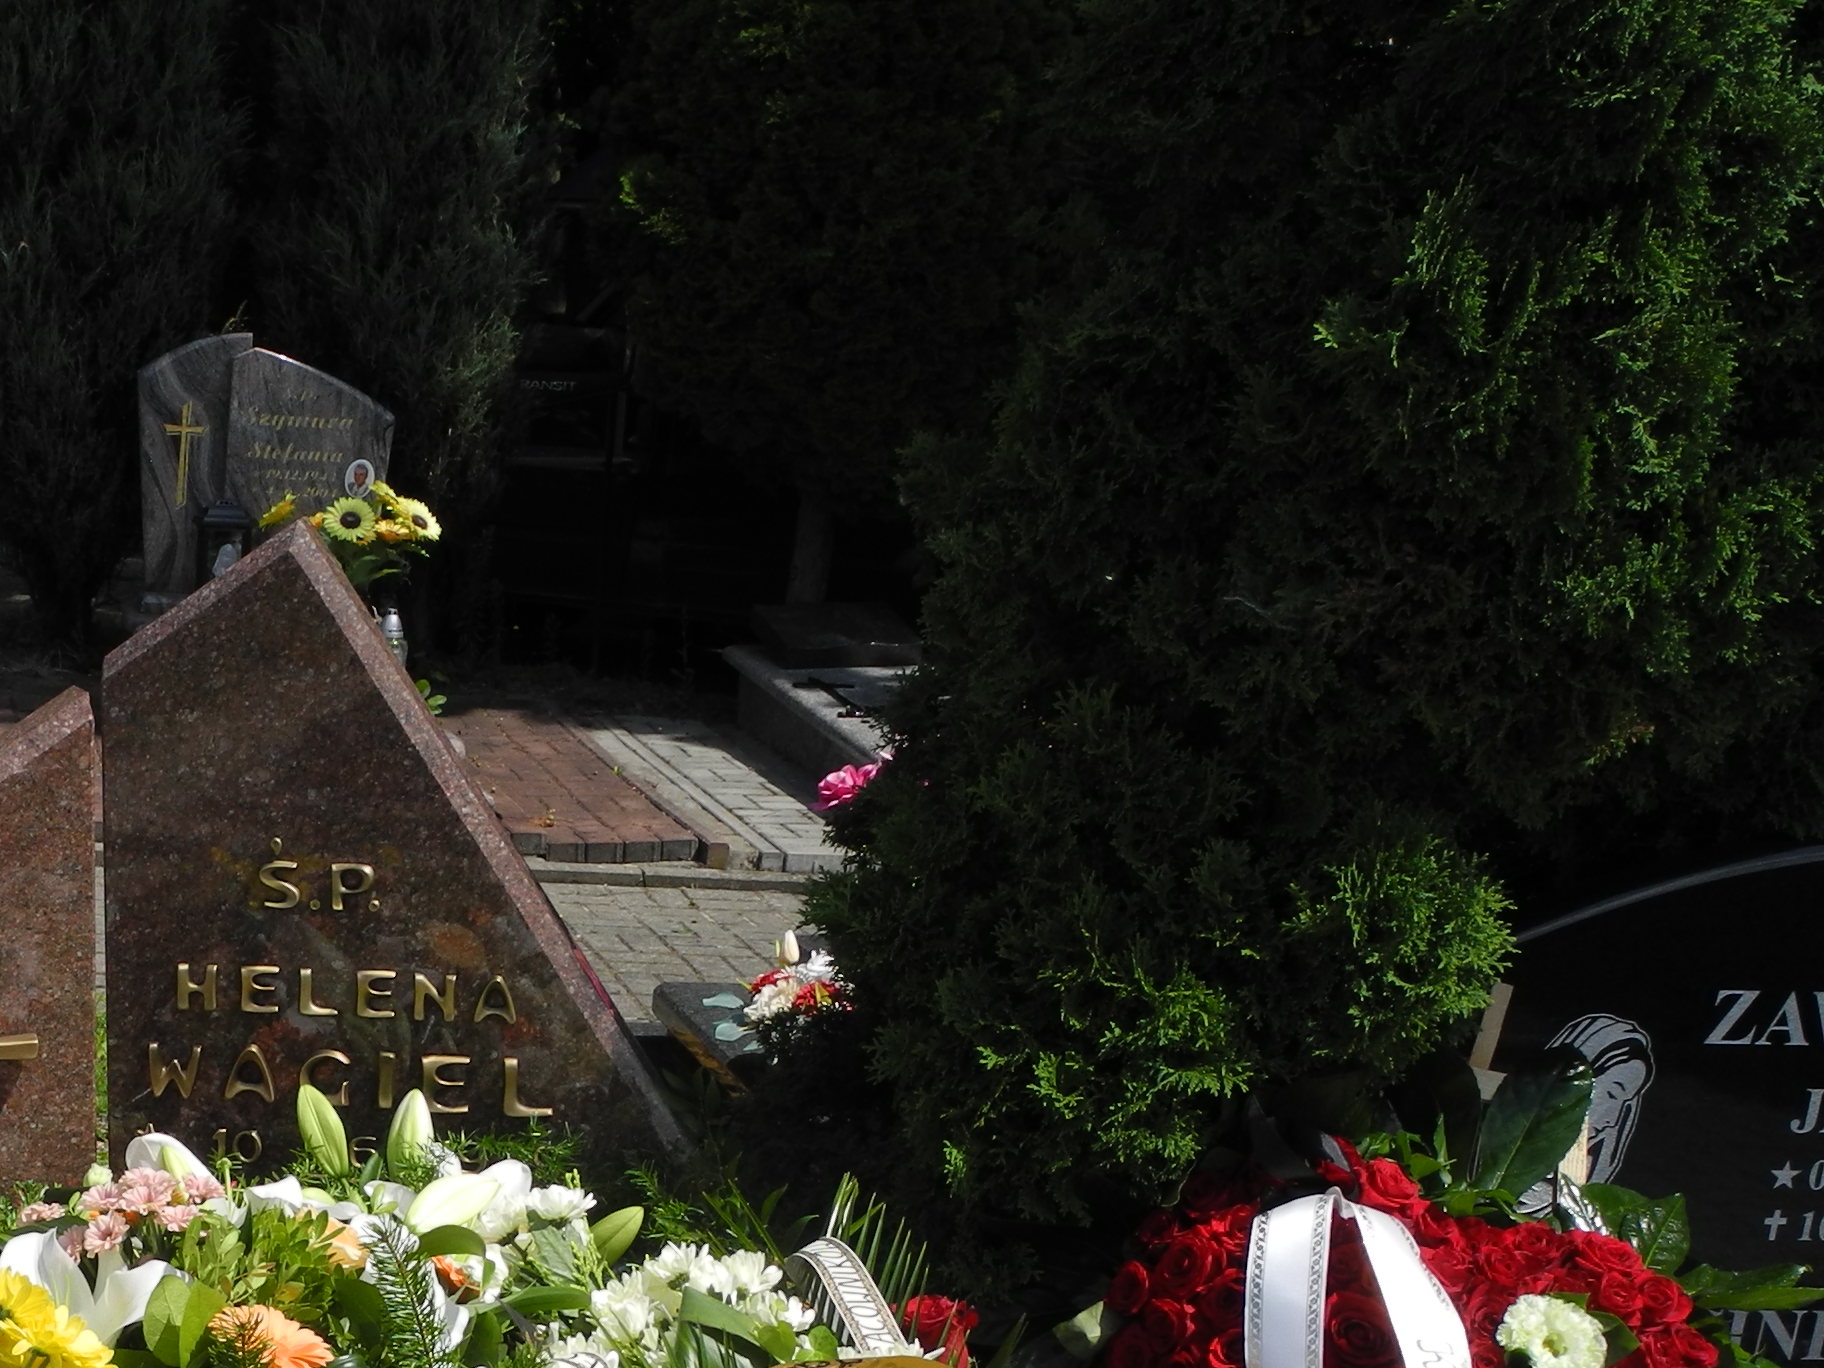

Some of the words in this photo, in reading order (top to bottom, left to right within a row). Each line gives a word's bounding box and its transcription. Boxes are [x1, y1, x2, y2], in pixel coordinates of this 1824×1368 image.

[519, 378, 577, 392] RANSIT
[258, 836, 382, 912] Ś.P.
[176, 961, 518, 1025] HELENA
[1703, 989, 1824, 1047] ZA
[148, 1041, 554, 1118] WAGIEL
